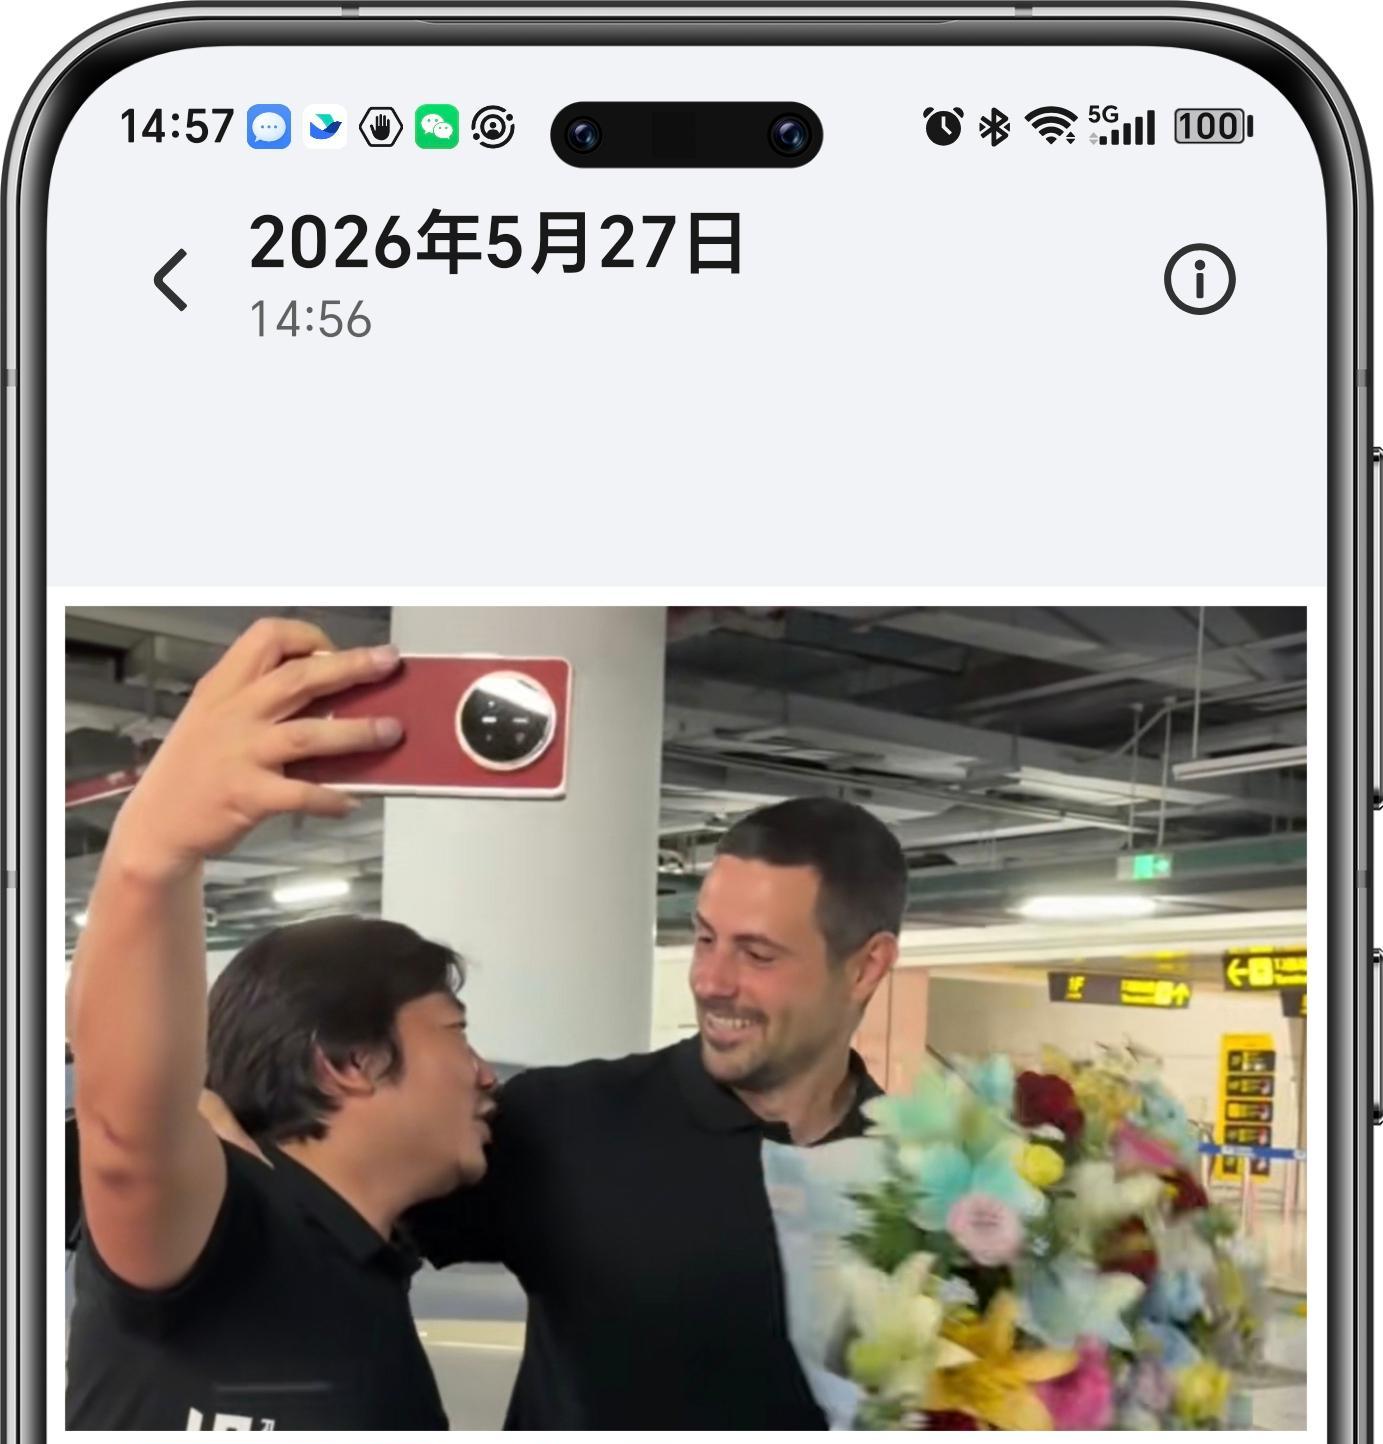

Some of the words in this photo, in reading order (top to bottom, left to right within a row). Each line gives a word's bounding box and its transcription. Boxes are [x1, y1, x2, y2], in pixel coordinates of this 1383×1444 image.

[121, 108, 235, 144] 14:57
[1088, 104, 1119, 123] 5G
[1179, 112, 1238, 140] 100
[250, 207, 740, 275] 2026年5月27日
[251, 300, 372, 338] 14:56
